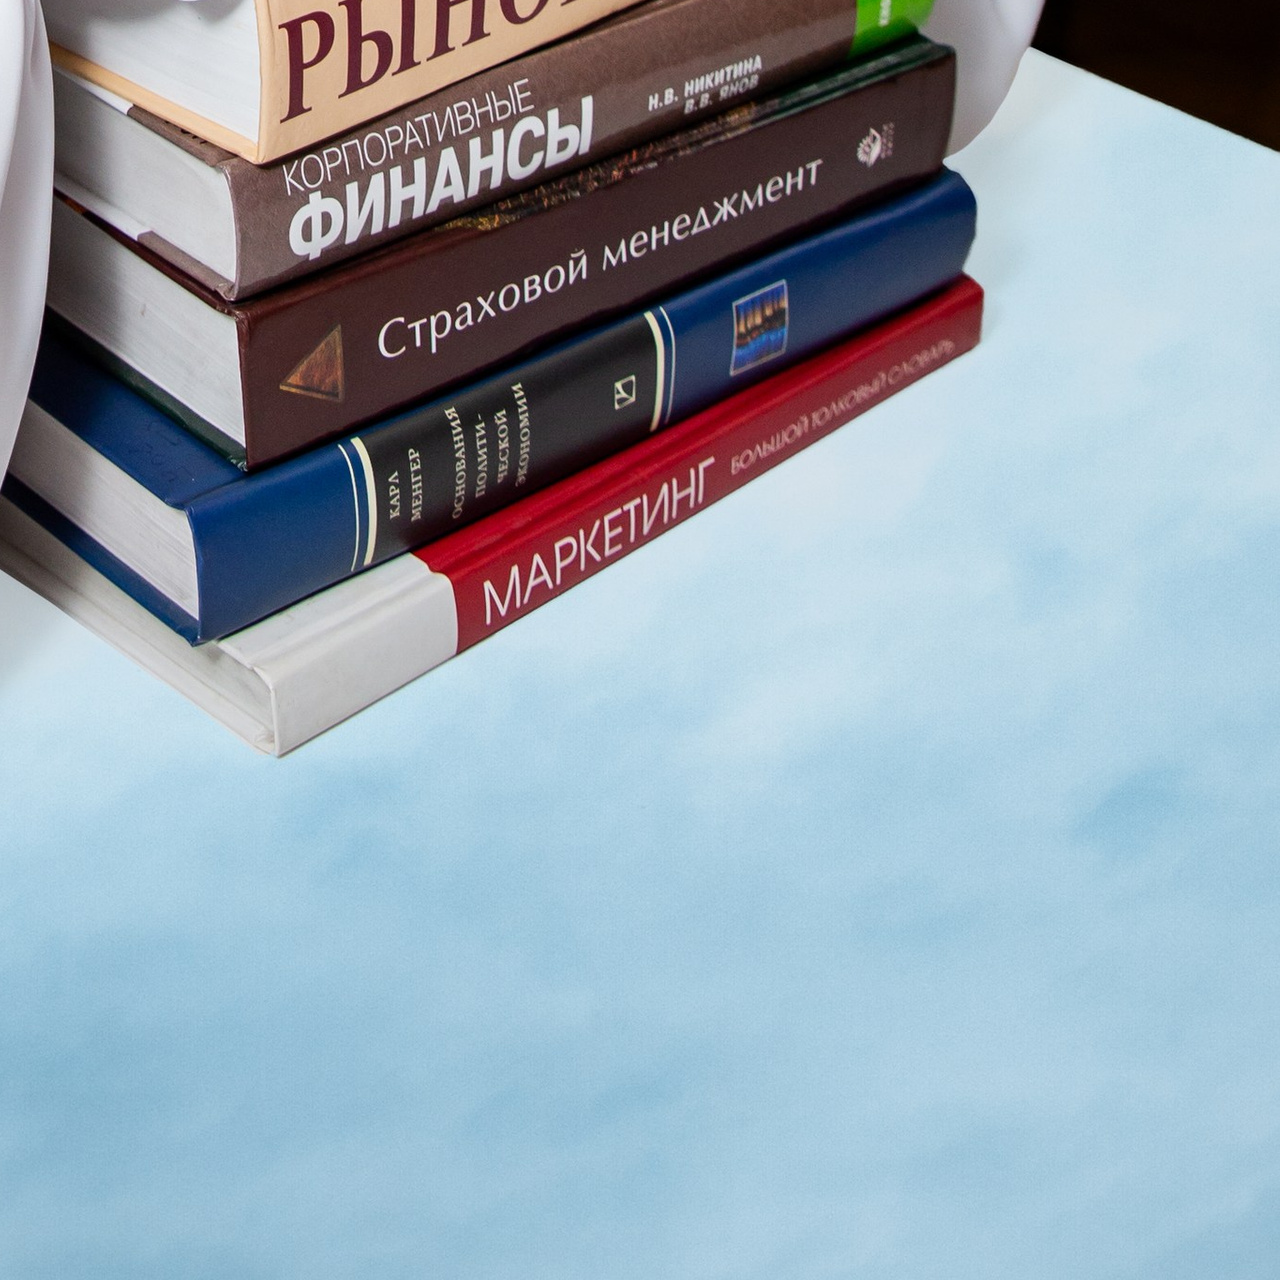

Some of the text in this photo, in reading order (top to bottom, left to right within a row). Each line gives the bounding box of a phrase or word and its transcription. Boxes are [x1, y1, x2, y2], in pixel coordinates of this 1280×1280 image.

[283, 78, 535, 196] КОРПОРАТИВНЫЕ
[648, 55, 762, 112] Н.В. НИКИТИНА
[684, 74, 760, 114] В.В. ЯНОВ
[288, 95, 593, 261] ФИНАНСЫ
[377, 159, 823, 359] Страховой менеджмент
[494, 409, 509, 484] ЧЕСКОЙ
[511, 382, 531, 487] ЭКОНОМИИ
[731, 339, 955, 476] БОЛЬШОЙ ТОЛКОВЫЙ СЛОВАРЬ
[388, 470, 401, 520] КАРЛ
[408, 448, 422, 522] МЕНГЕР
[444, 406, 466, 519] ОСНОВАНИЯ
[483, 455, 716, 626] МАРКЕТИНГ
